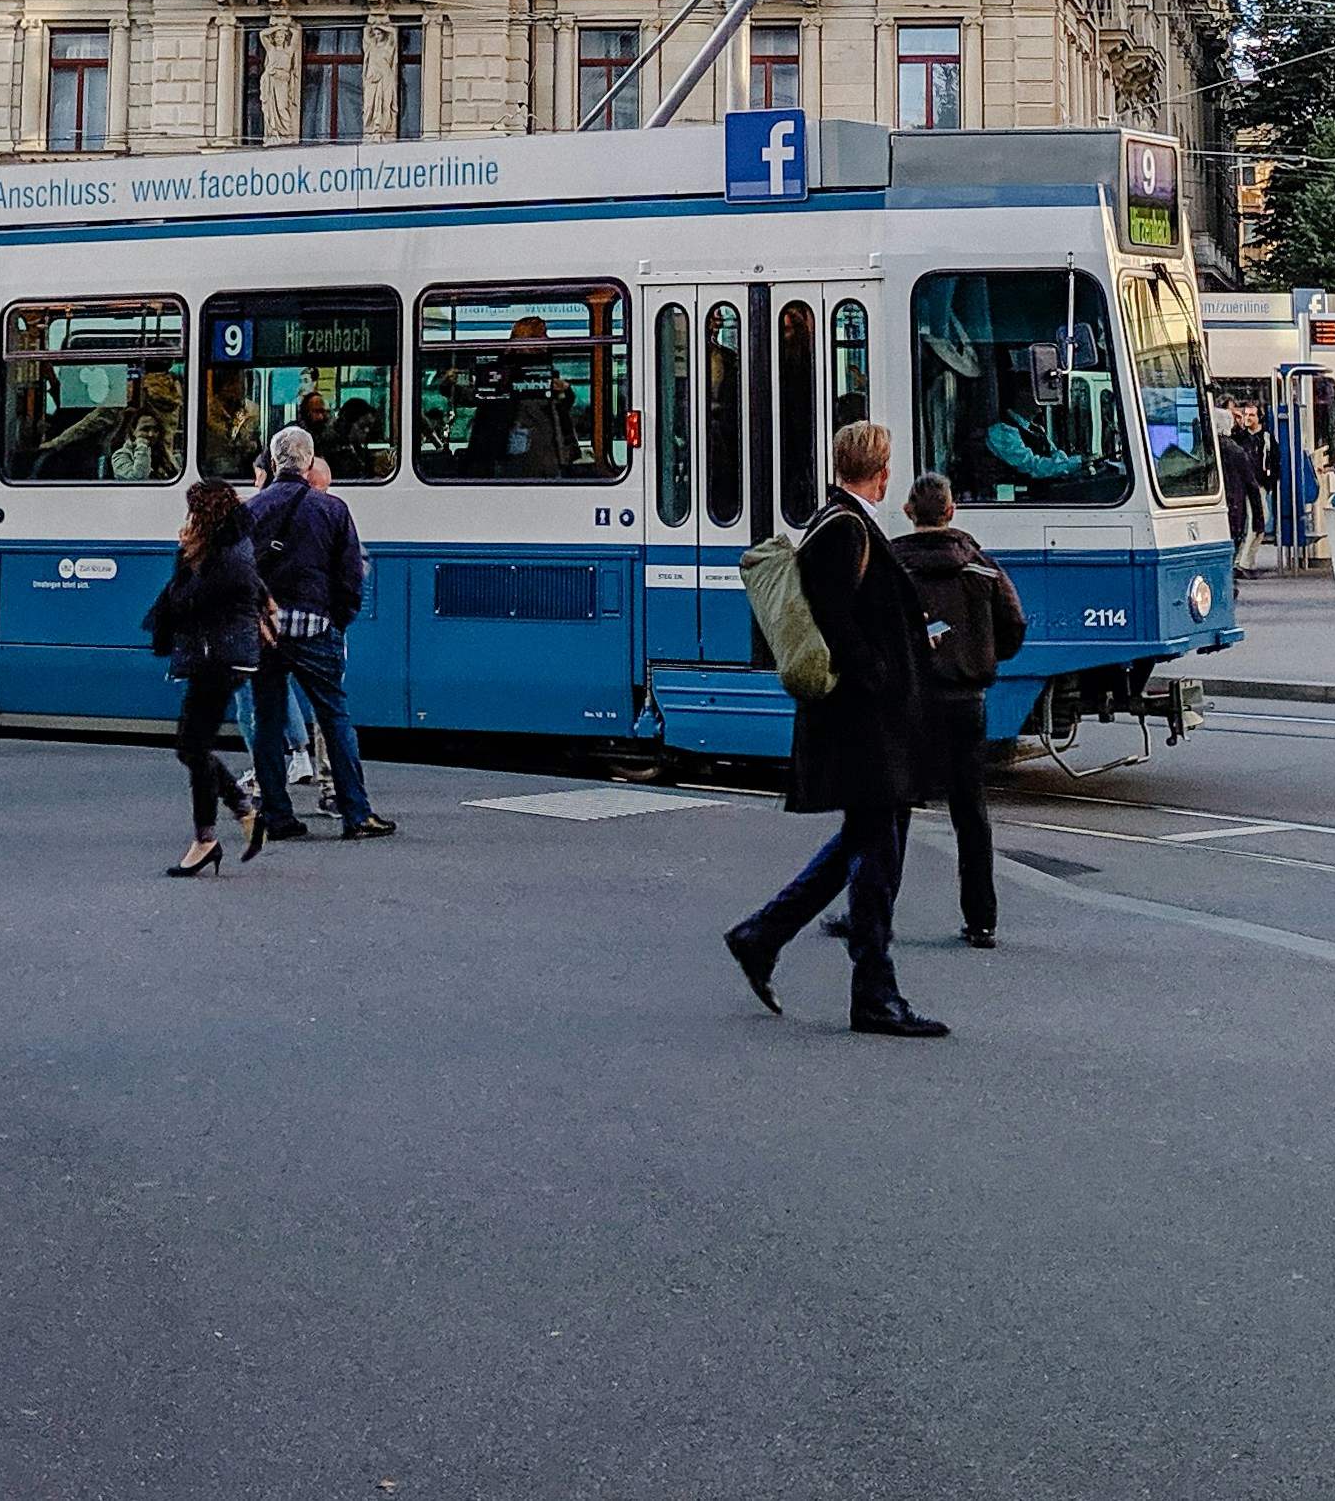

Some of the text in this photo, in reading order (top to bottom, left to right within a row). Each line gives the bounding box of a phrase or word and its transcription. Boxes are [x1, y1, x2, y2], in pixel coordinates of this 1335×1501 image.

[131, 155, 500, 203] www.facebook.com/zuerilinie
[1142, 148, 1156, 196] 9
[224, 324, 243, 357] 9
[286, 318, 371, 355] Hirzenbach
[1084, 608, 1127, 627] 2114
